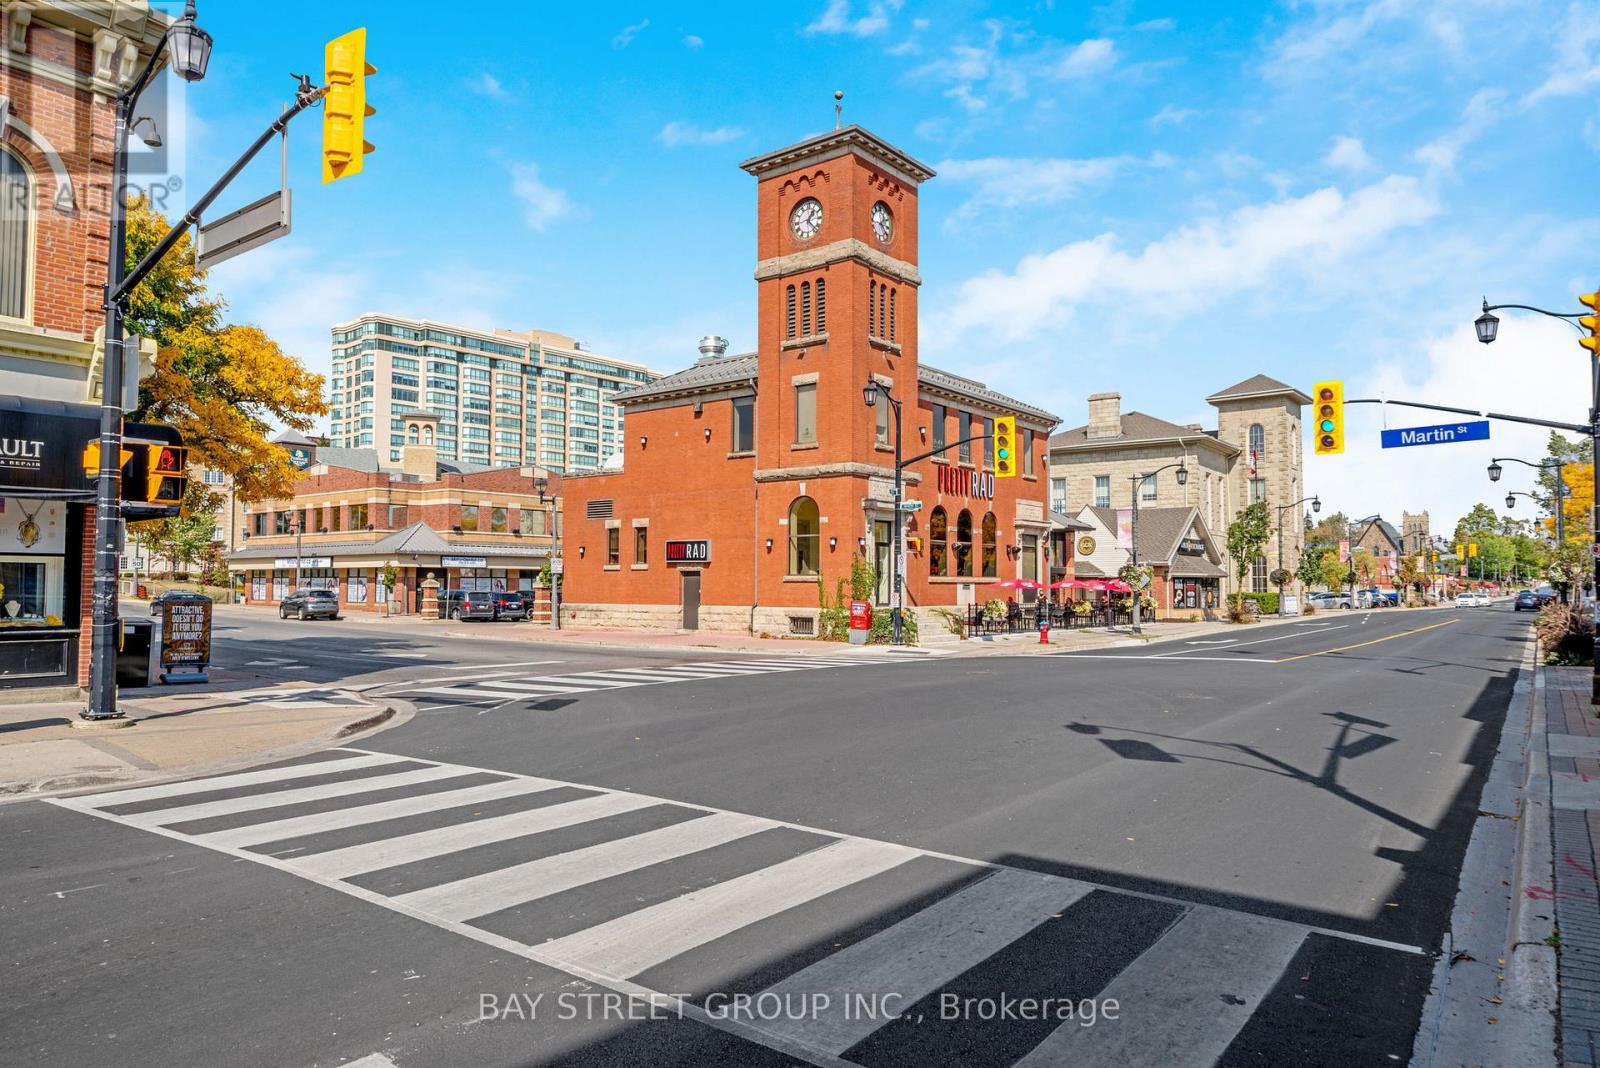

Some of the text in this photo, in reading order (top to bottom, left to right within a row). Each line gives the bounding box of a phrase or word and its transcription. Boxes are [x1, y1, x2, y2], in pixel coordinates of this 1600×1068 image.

[1401, 426, 1468, 444] Martin St
[938, 463, 995, 501] PRETTY RAD
[686, 543, 706, 559] RAD
[172, 623, 203, 632] IT FOR YOU
[171, 632, 203, 641] ANYMORE?
